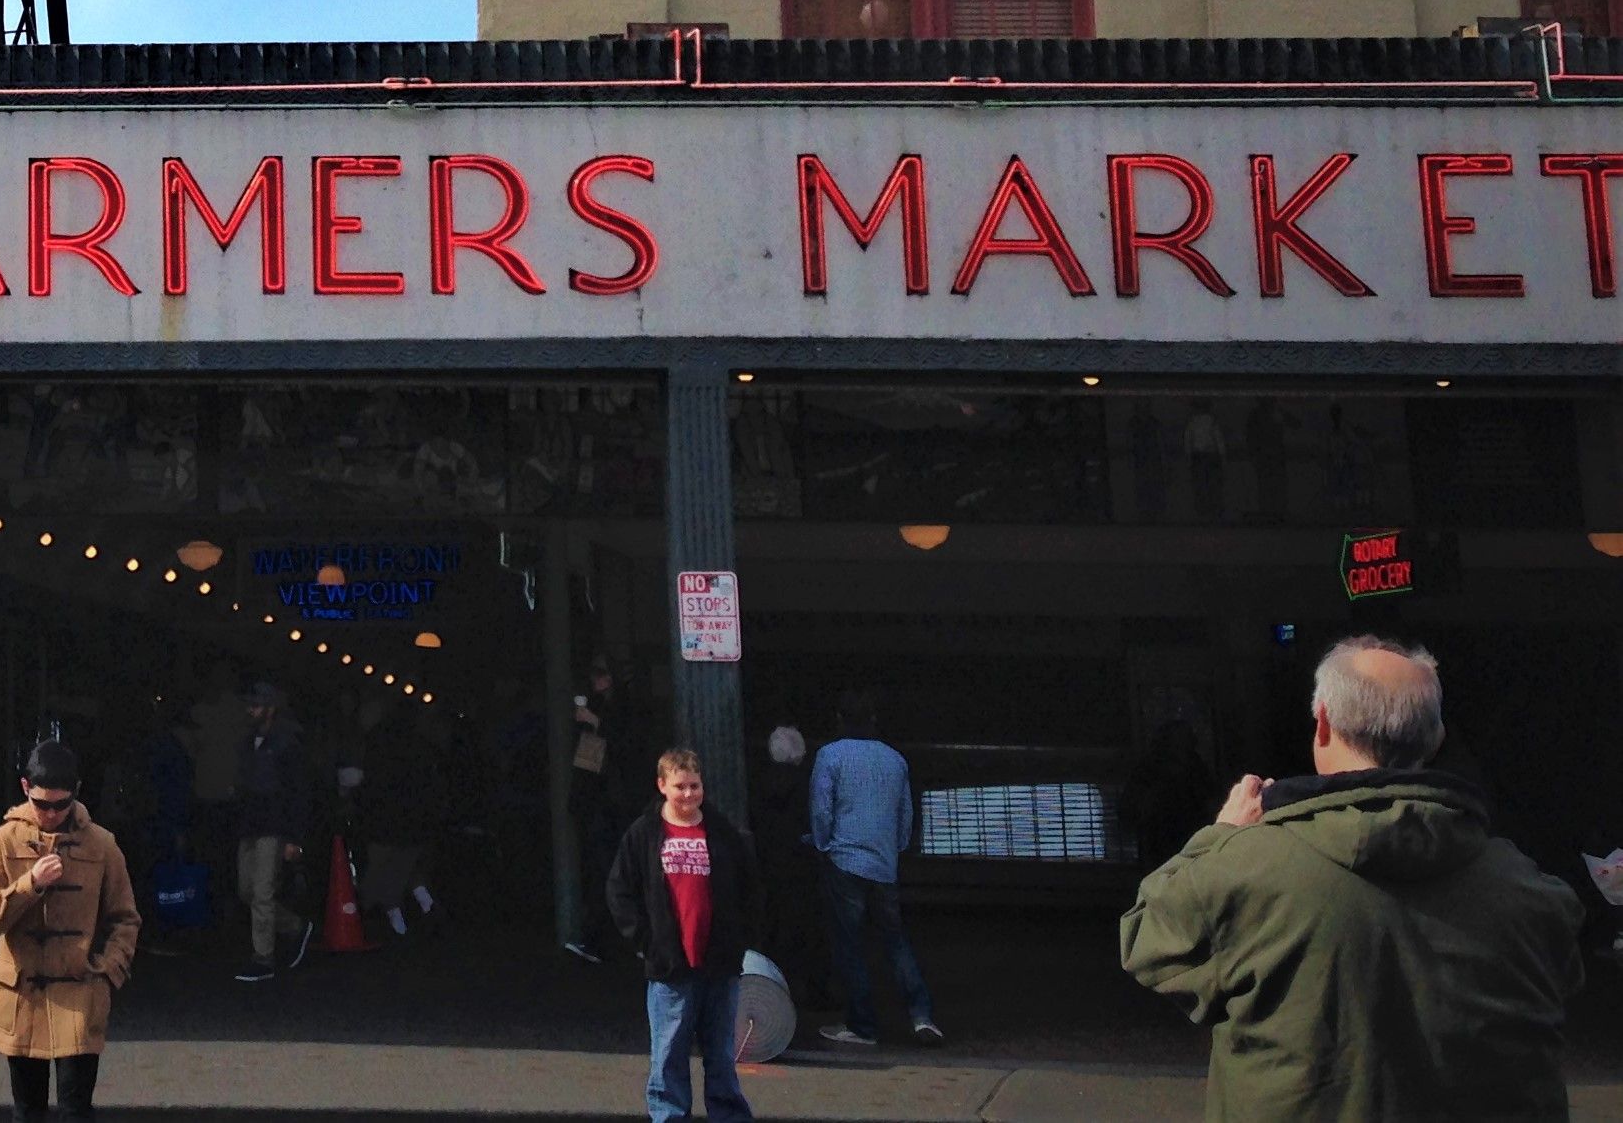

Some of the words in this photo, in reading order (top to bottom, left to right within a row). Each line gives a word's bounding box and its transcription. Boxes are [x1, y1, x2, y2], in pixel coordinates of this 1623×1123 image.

[796, 153, 1623, 298] MARKET
[249, 543, 463, 575] WATERFRONT
[683, 575, 706, 592] NO
[1349, 561, 1411, 594] GROCERY
[277, 579, 436, 606] VIEWPOINT
[686, 598, 731, 612] STOPS
